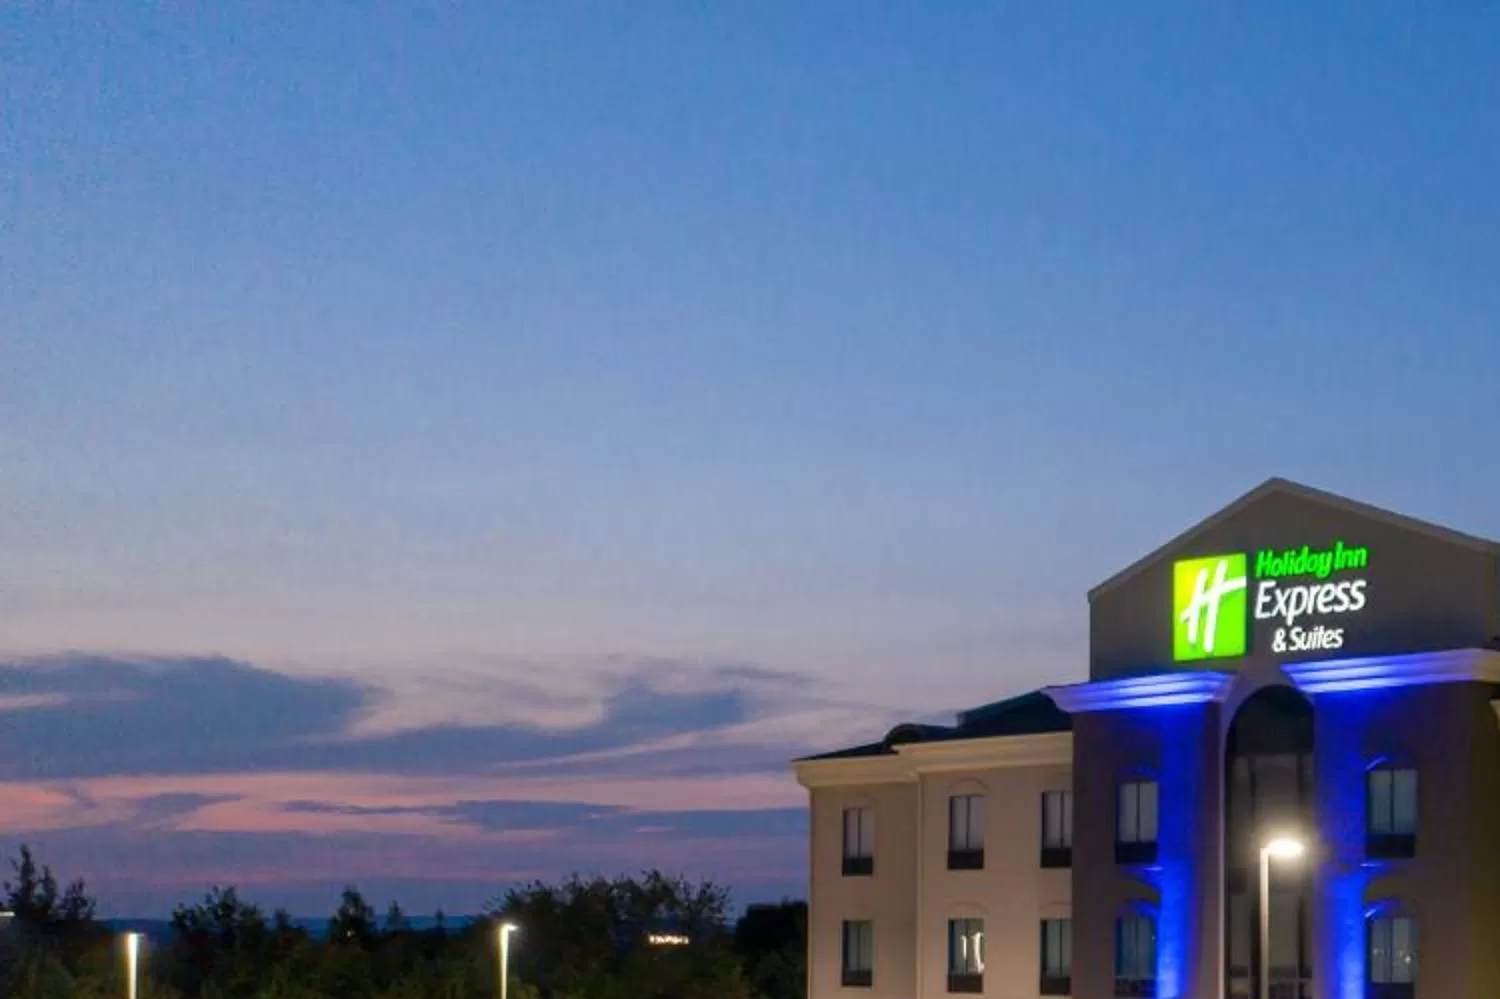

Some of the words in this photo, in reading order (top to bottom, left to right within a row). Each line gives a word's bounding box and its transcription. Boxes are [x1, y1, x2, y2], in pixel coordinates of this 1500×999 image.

[1256, 546, 1332, 578] Holiday
[1335, 542, 1367, 568] Inn
[1255, 579, 1367, 625] Express
[1272, 628, 1287, 652] &
[1289, 625, 1344, 651] Suites
